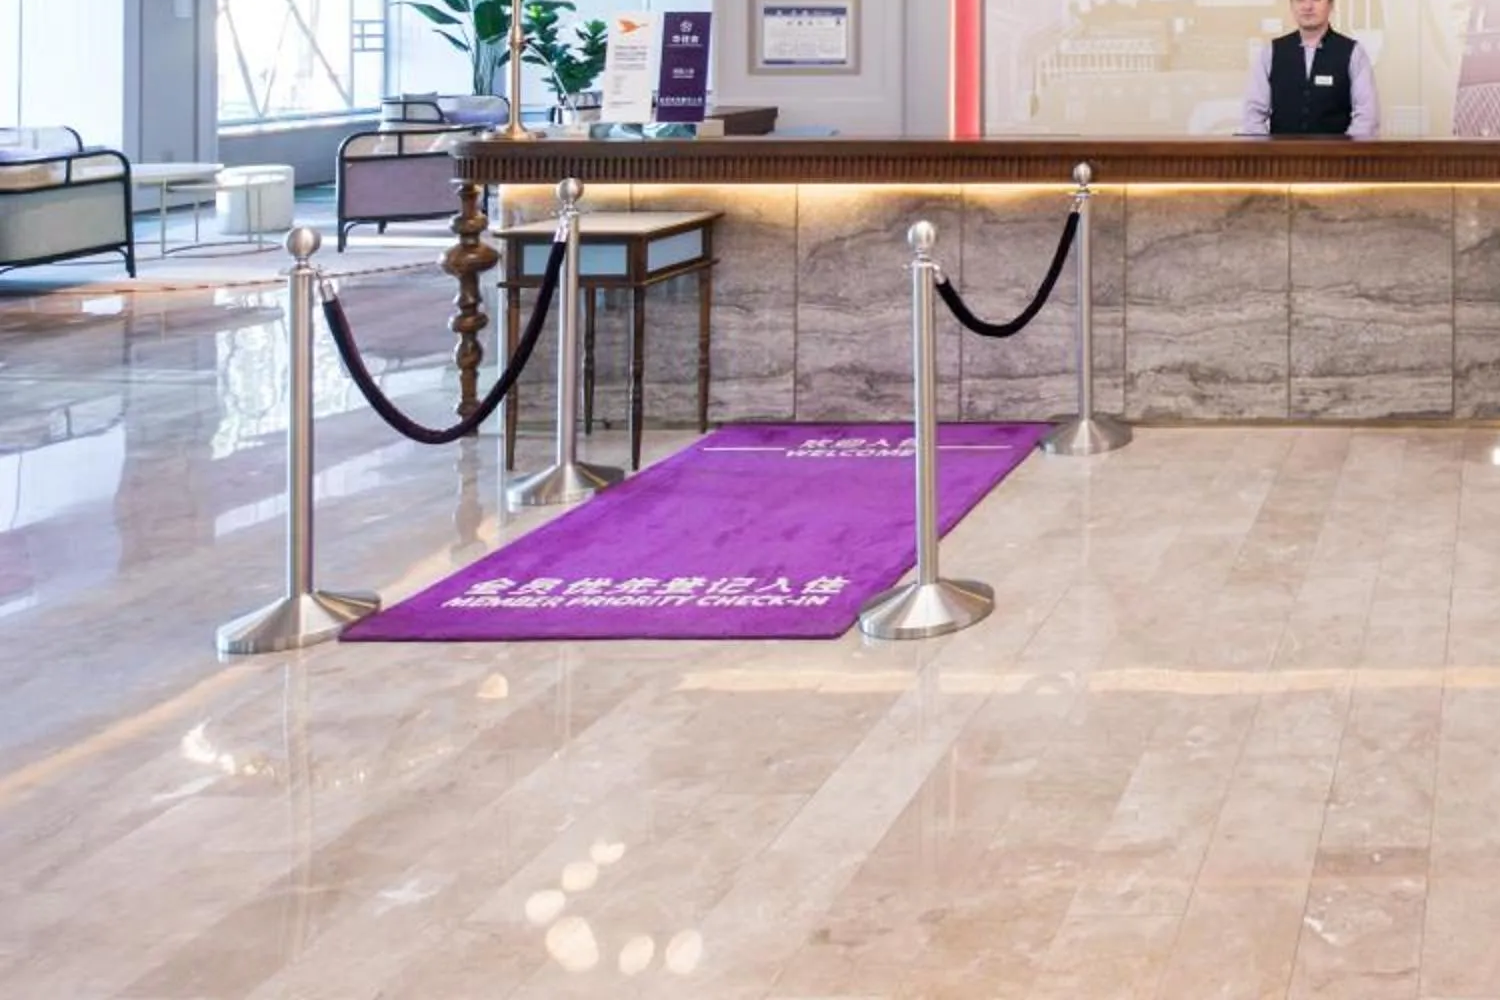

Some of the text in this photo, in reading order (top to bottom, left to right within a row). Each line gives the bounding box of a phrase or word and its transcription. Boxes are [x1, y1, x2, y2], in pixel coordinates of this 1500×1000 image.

[786, 449, 917, 457] WELCOME
[464, 577, 850, 595] 会员优先登记入住
[440, 595, 831, 607] MEMBER PRIORITY CHECK-IN
